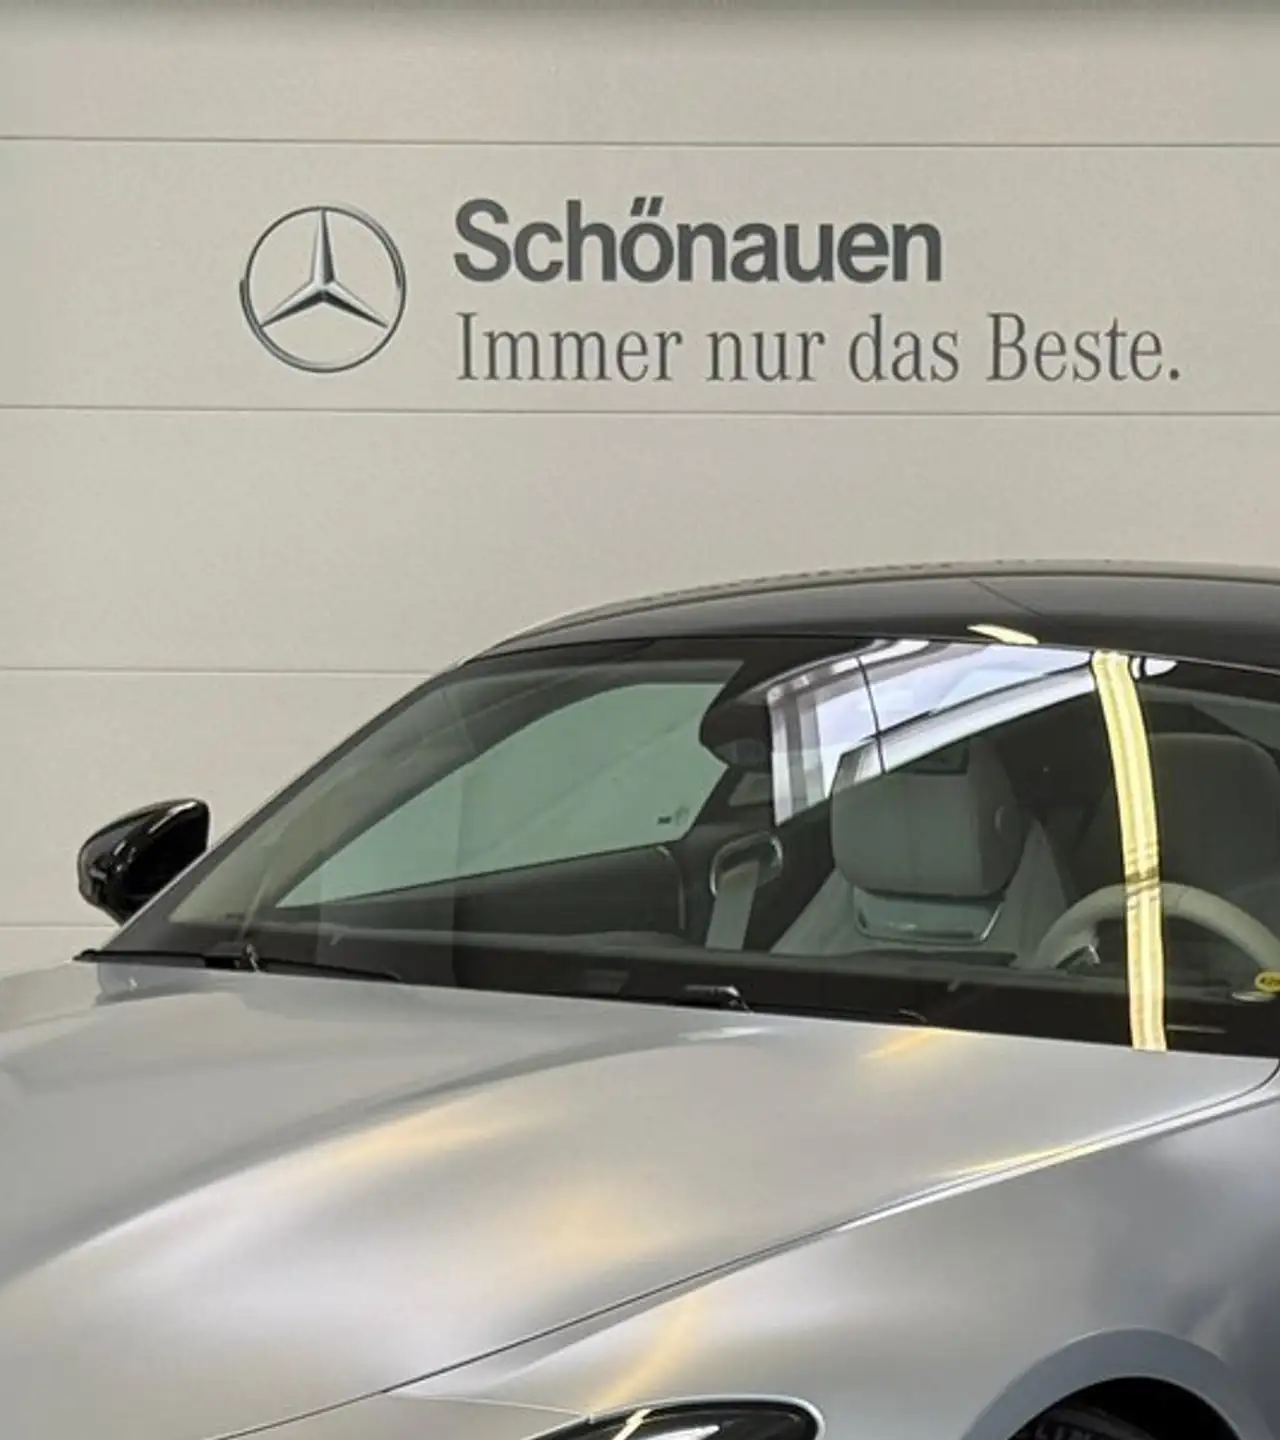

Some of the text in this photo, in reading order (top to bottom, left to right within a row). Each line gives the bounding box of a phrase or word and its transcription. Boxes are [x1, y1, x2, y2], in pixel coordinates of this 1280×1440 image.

[453, 196, 942, 285] Schönauen
[455, 311, 1180, 383] Immer nur das Beste.
